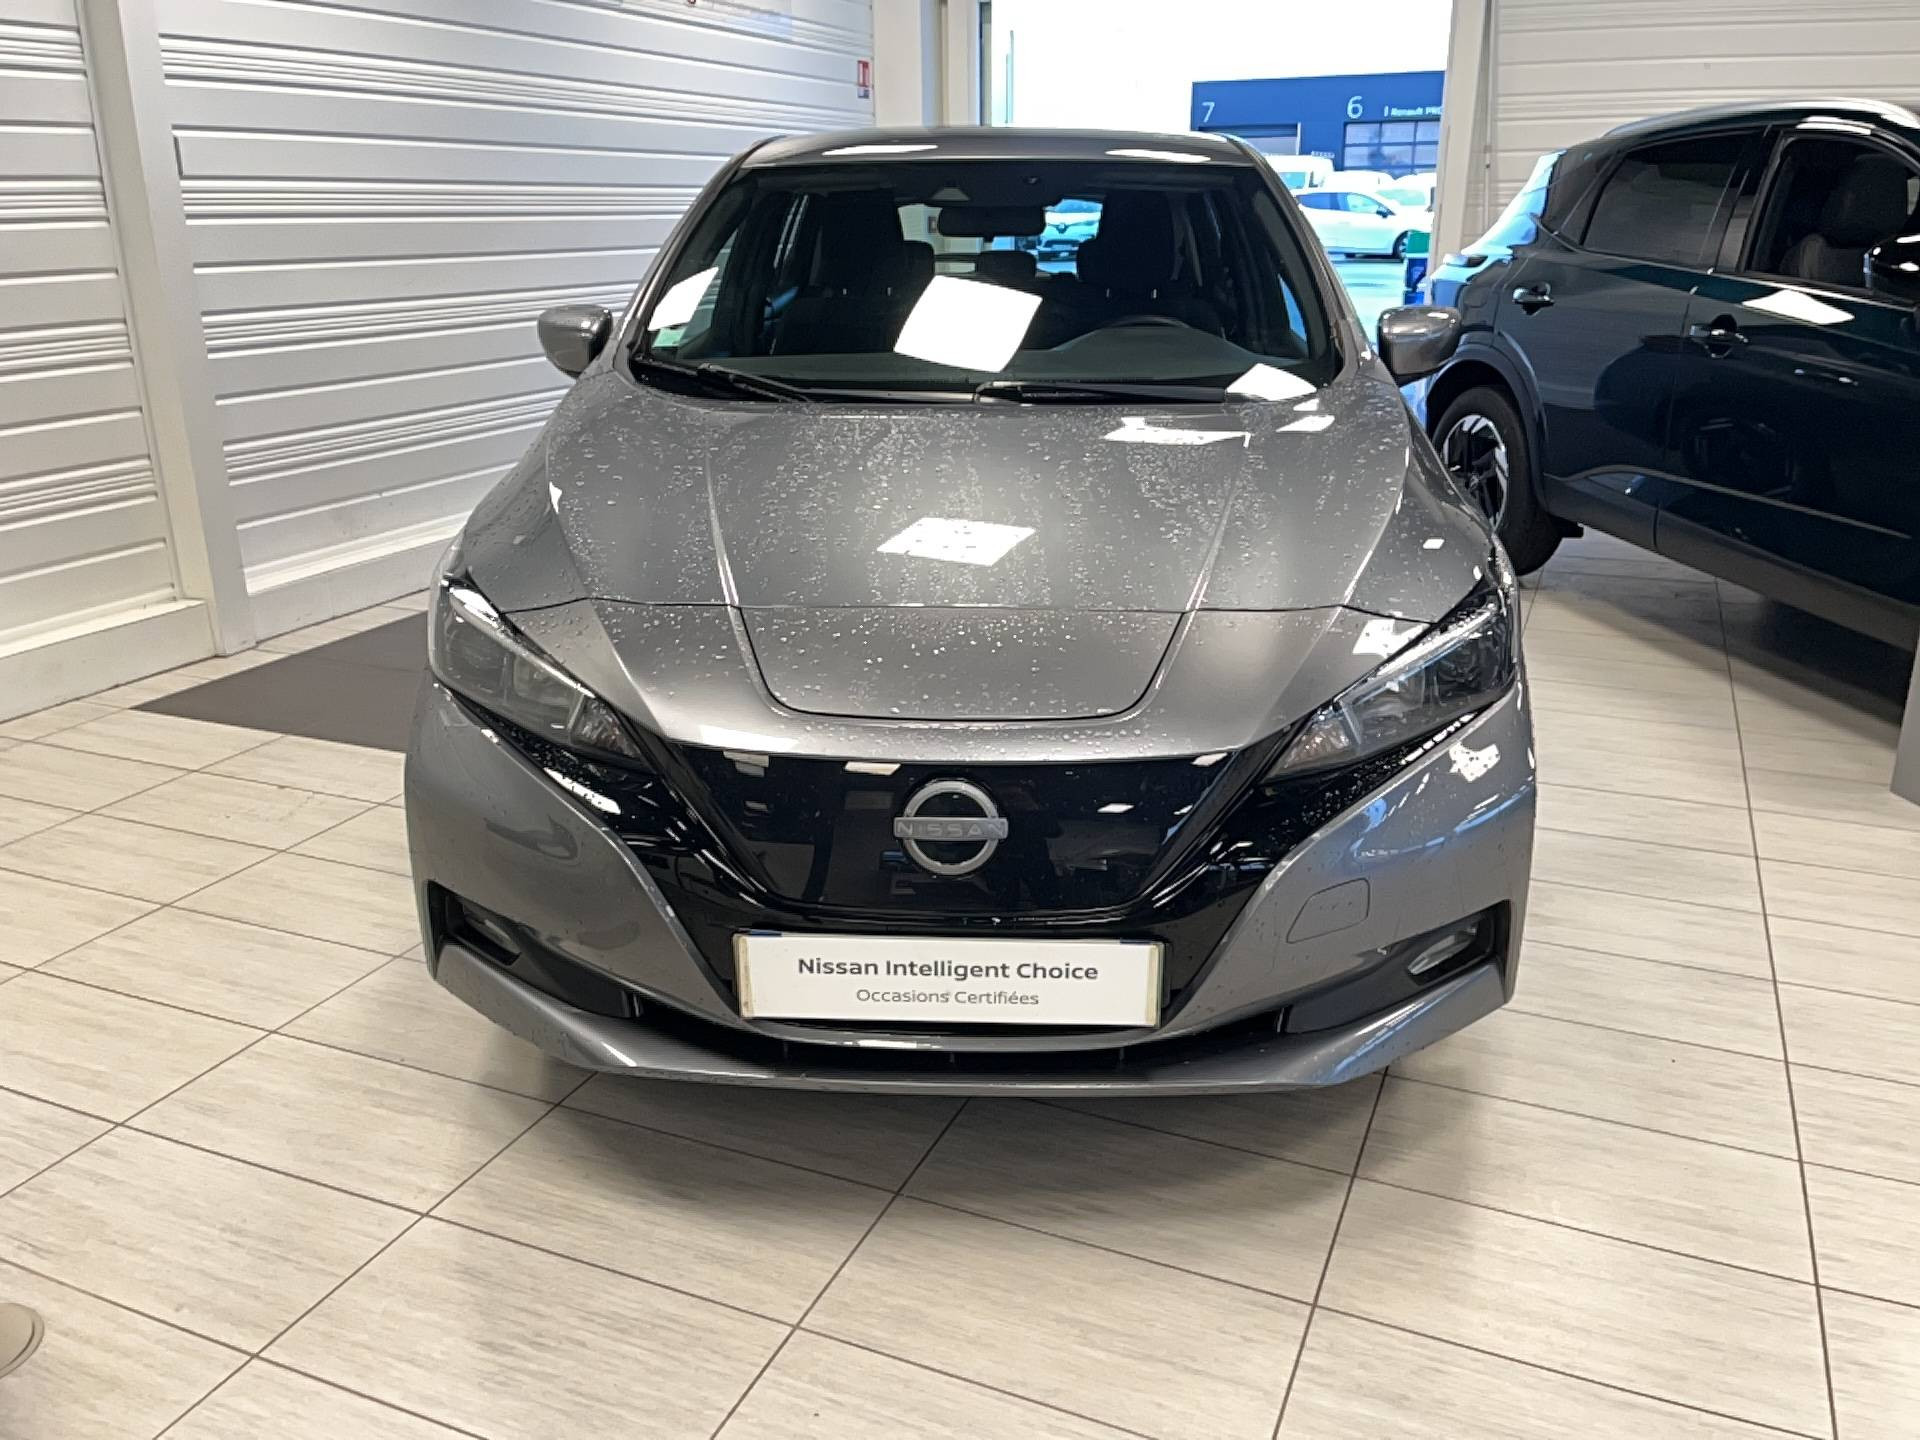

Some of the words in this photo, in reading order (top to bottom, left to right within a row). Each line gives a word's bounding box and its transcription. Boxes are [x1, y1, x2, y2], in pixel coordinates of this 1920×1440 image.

[1202, 101, 1216, 123] 7
[1346, 95, 1363, 119] 6
[897, 821, 1003, 838] NISSAN
[798, 959, 879, 976] Nissan
[886, 960, 1010, 982] Intelligent
[1016, 963, 1098, 980] Choice
[856, 989, 949, 1003] Occasions
[954, 990, 1040, 1007] Certifiées
